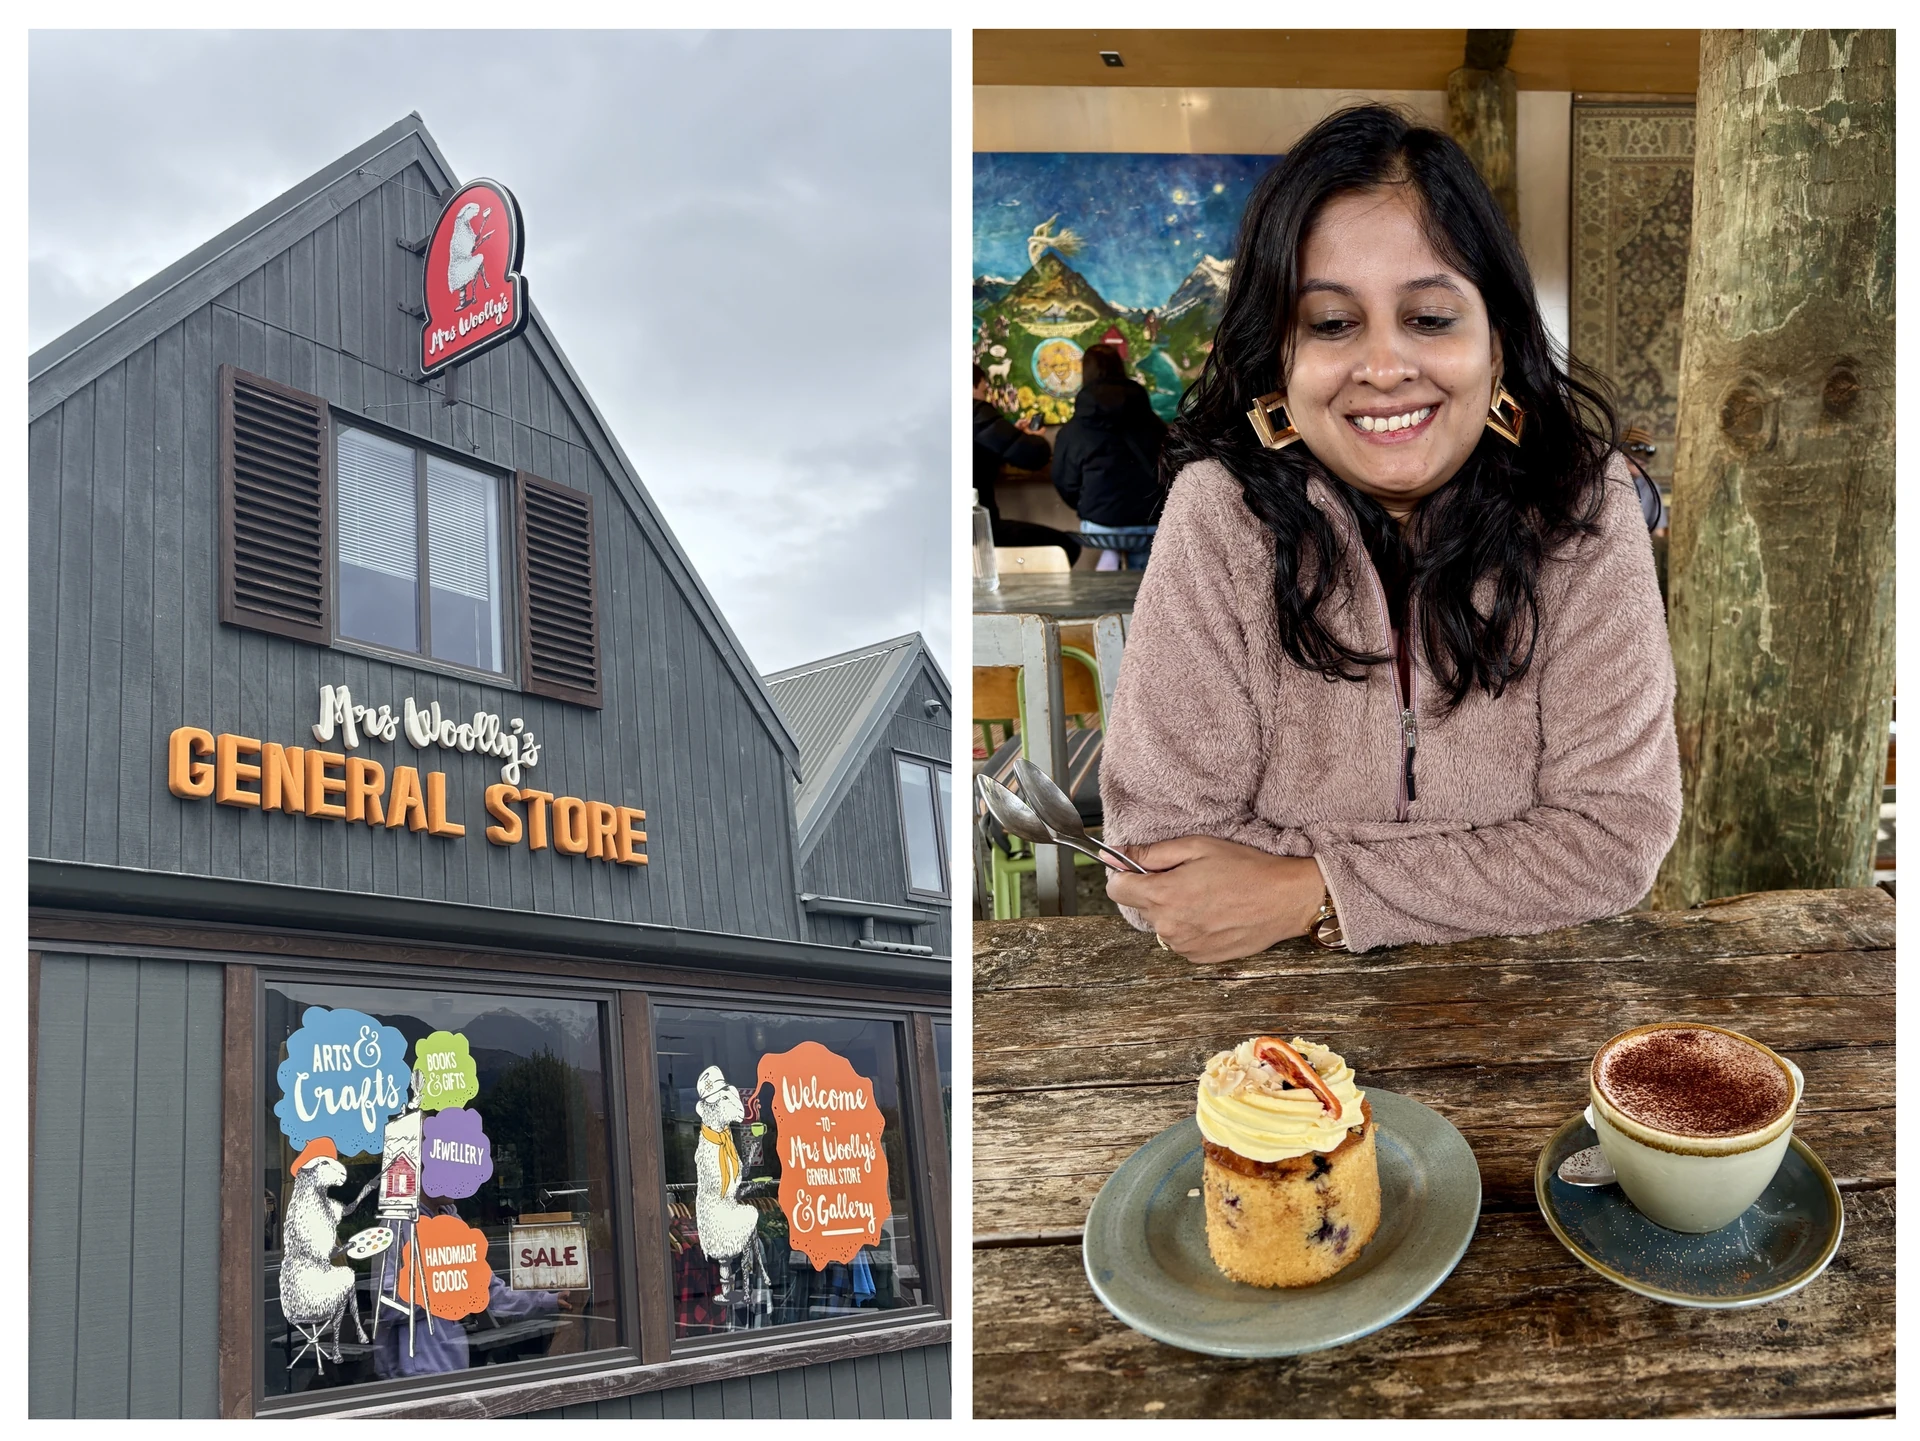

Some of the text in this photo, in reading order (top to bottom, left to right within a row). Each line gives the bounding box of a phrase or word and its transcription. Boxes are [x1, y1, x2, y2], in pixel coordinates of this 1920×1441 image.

[429, 294, 508, 354] Mrs Woolly's
[312, 684, 541, 785] Mrs Woolly's
[168, 726, 648, 866] GENERAL STORE
[312, 1025, 381, 1072] ARTS &
[426, 1051, 457, 1071] BOOKS
[294, 1068, 401, 1133] Crafts
[426, 1072, 466, 1097] & GIFTS
[782, 1075, 869, 1113] Welcome
[429, 1138, 484, 1166] JEWELLERY
[788, 1132, 876, 1173] Mrs Woolly's
[806, 1166, 862, 1186] GENERAL STORE
[792, 1188, 876, 1234] & Gallery
[425, 1243, 477, 1267] HANDMADE
[520, 1245, 578, 1268] SALE
[432, 1269, 468, 1293] GOODS
